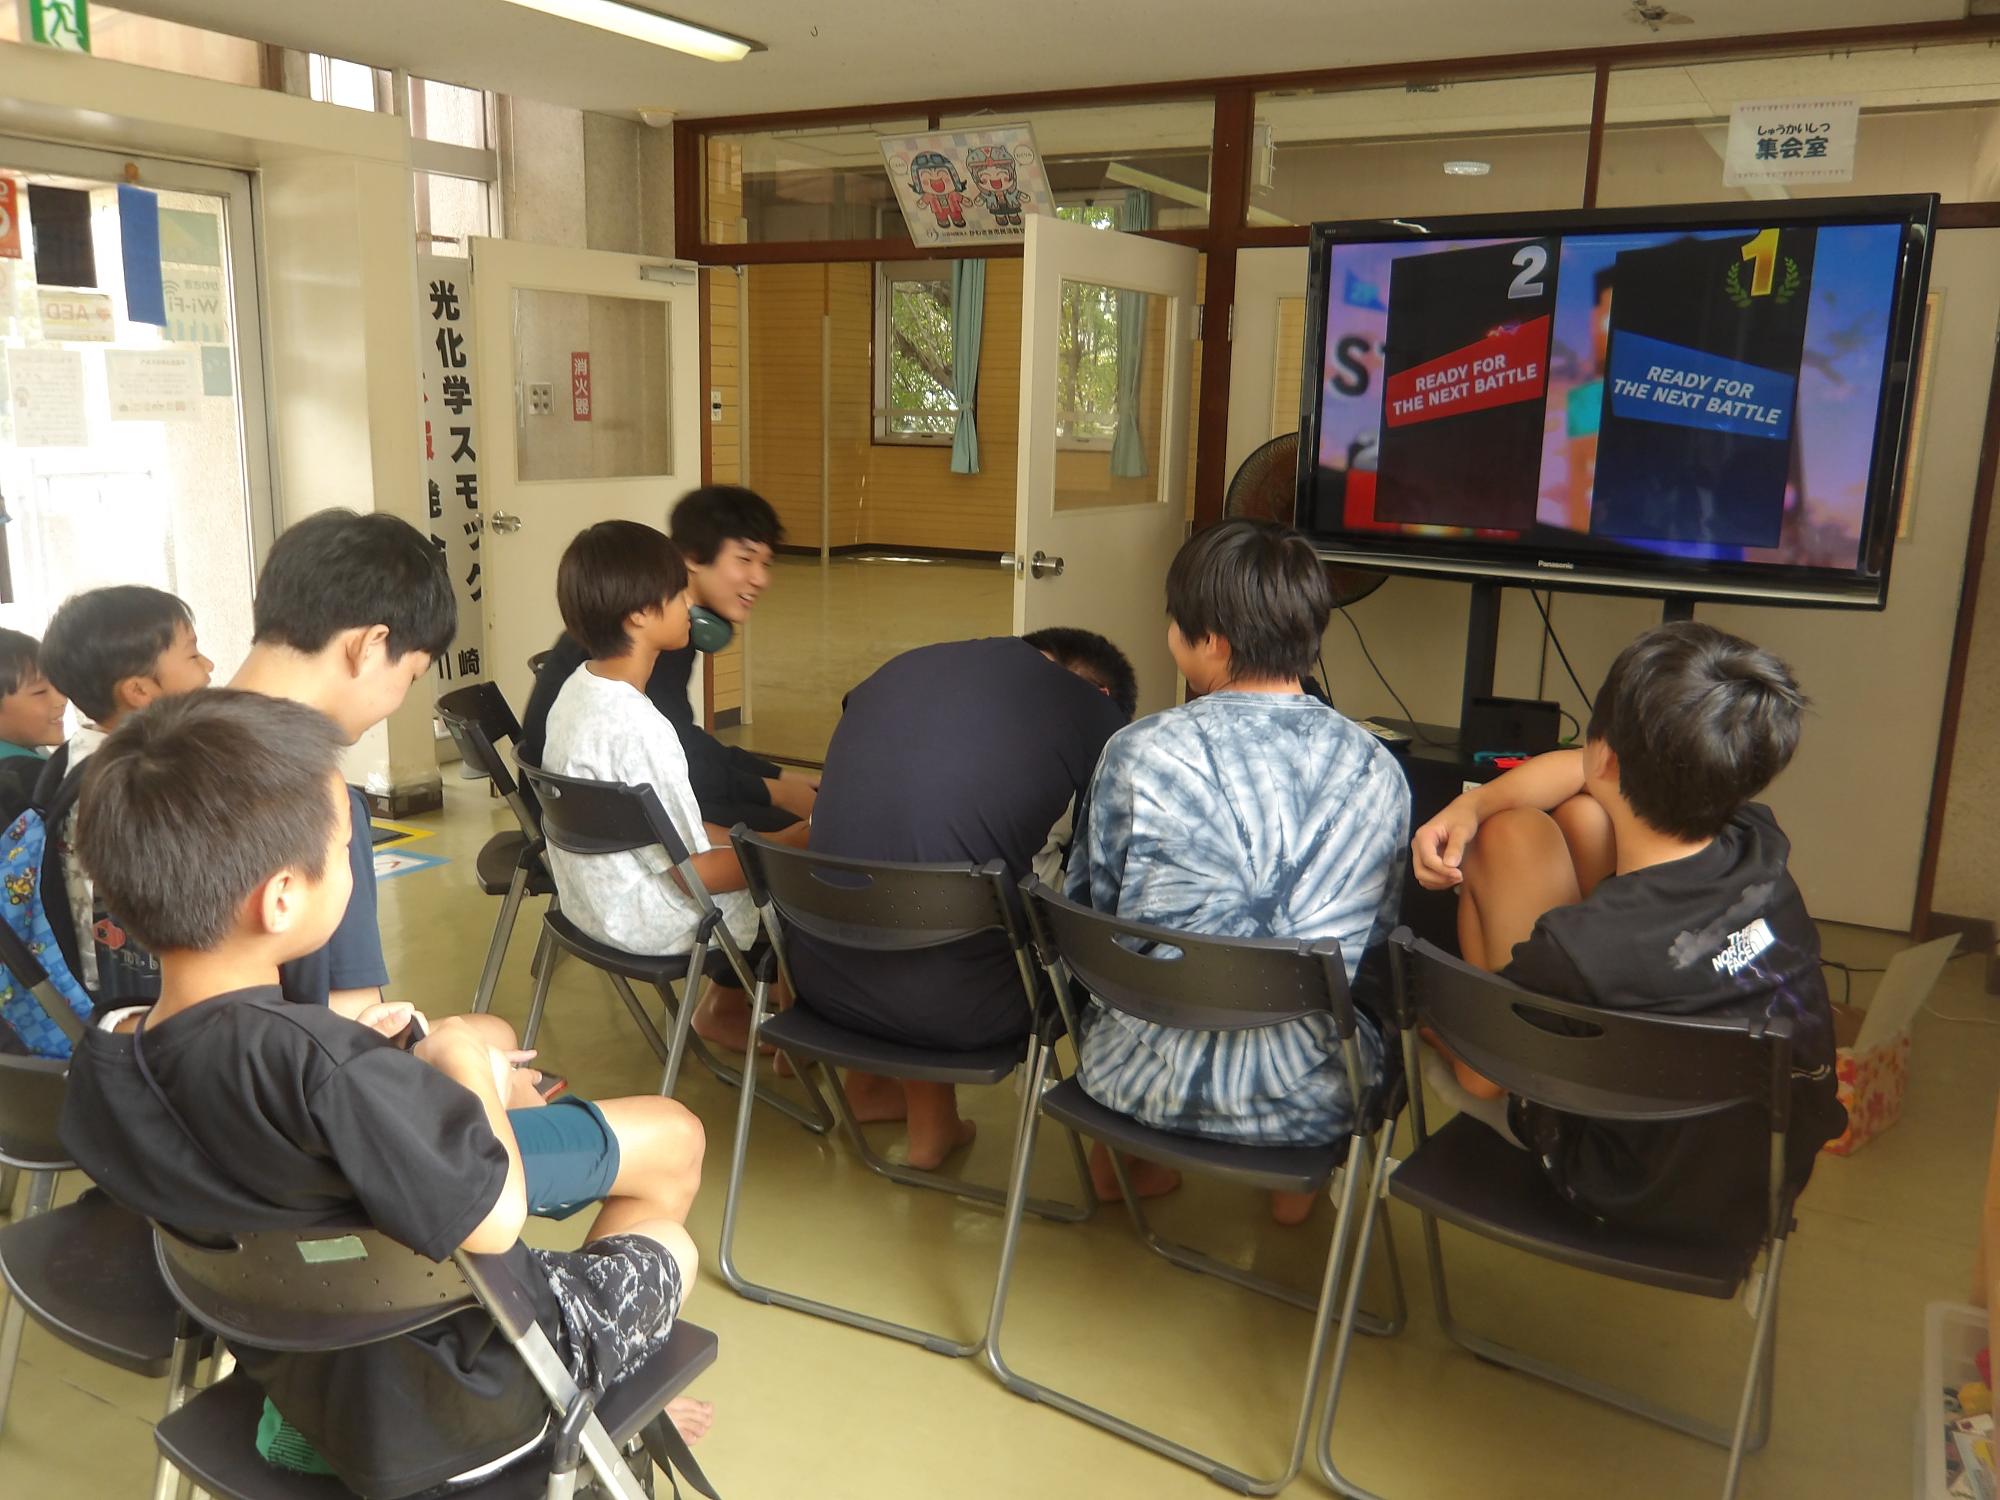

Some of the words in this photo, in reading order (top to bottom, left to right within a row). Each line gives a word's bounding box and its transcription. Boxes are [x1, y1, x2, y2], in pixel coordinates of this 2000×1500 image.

[1755, 136, 1829, 160] 集会室
[1757, 122, 1831, 136] しゅうかいしつ
[1508, 245, 1548, 299] 2
[1741, 228, 1780, 297] 1
[574, 358, 590, 415] 消火器
[1393, 395, 1424, 416] THE
[1428, 382, 1470, 406] NEXT
[1474, 363, 1537, 394] BATTLE
[1415, 364, 1468, 392] READY
[1473, 354, 1506, 376] FOR
[1647, 366, 1712, 390] READY
[1713, 379, 1755, 399] FOR
[1613, 378, 1651, 398] THE
[1652, 387, 1704, 409] NEXT
[1705, 397, 1782, 425] BATTLE
[1726, 944, 1756, 976] FACE
